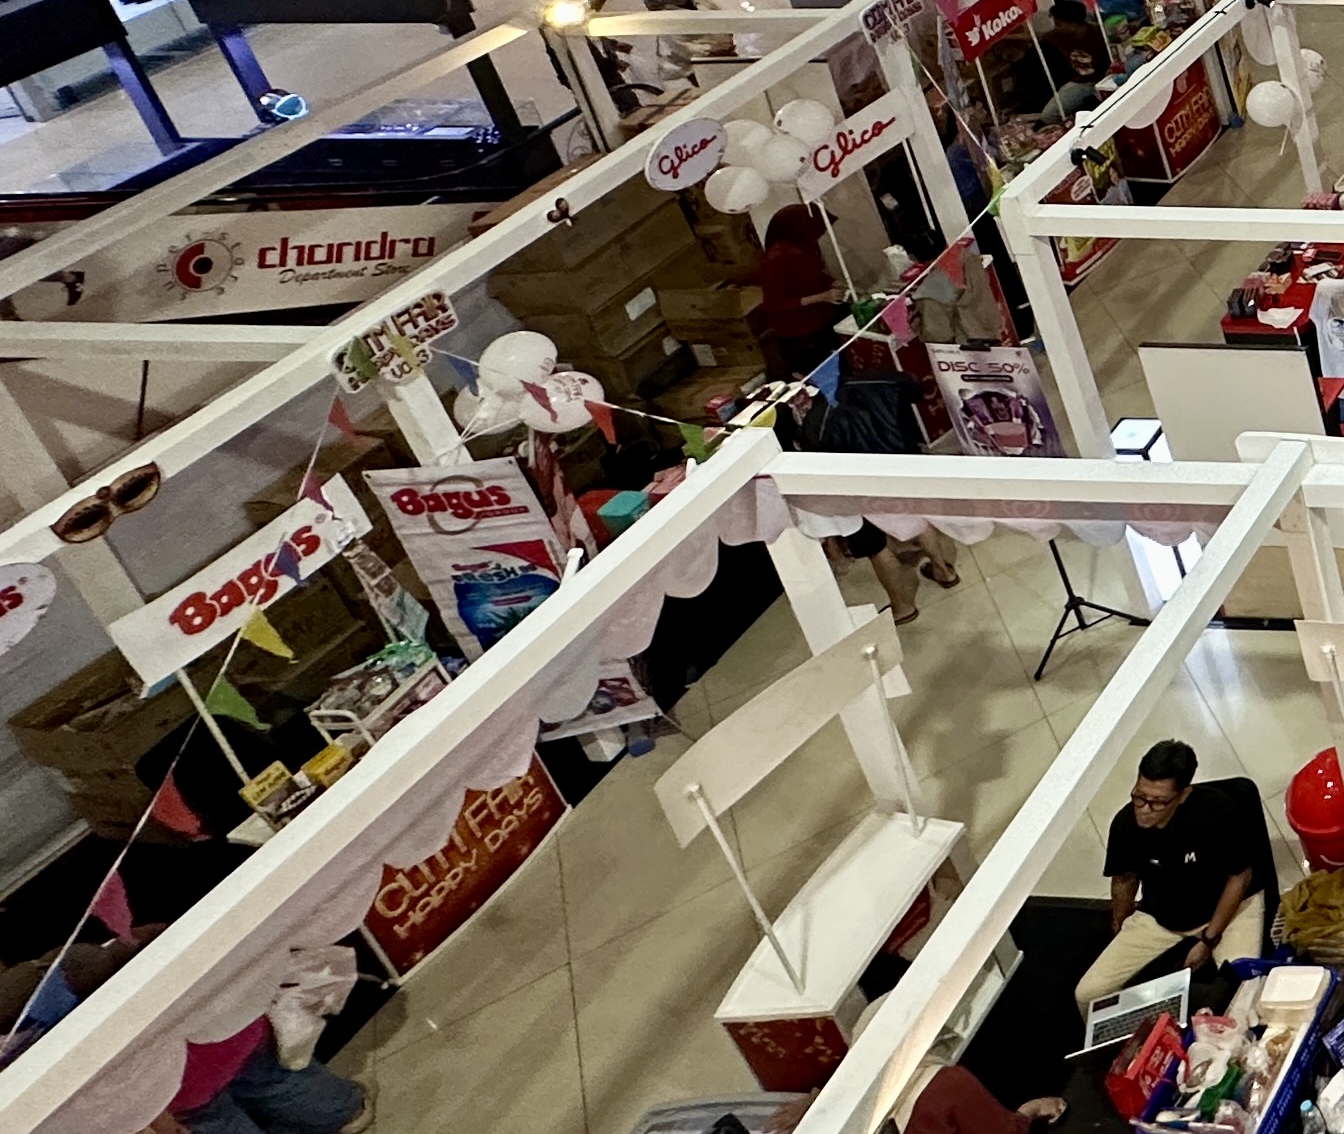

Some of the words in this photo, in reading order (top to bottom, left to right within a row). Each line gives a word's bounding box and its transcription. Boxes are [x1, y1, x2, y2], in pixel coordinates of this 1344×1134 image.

[982, 6, 1024, 41] Koko
[658, 134, 717, 179] Glico
[813, 116, 896, 178] Glico
[257, 232, 435, 270] chandra
[279, 266, 367, 284] Department
[938, 360, 981, 373] DISC
[987, 361, 1030, 374] 50%
[390, 485, 511, 519] Bagus
[393, 848, 480, 938] HAPPY
[484, 789, 544, 854] DAYS
